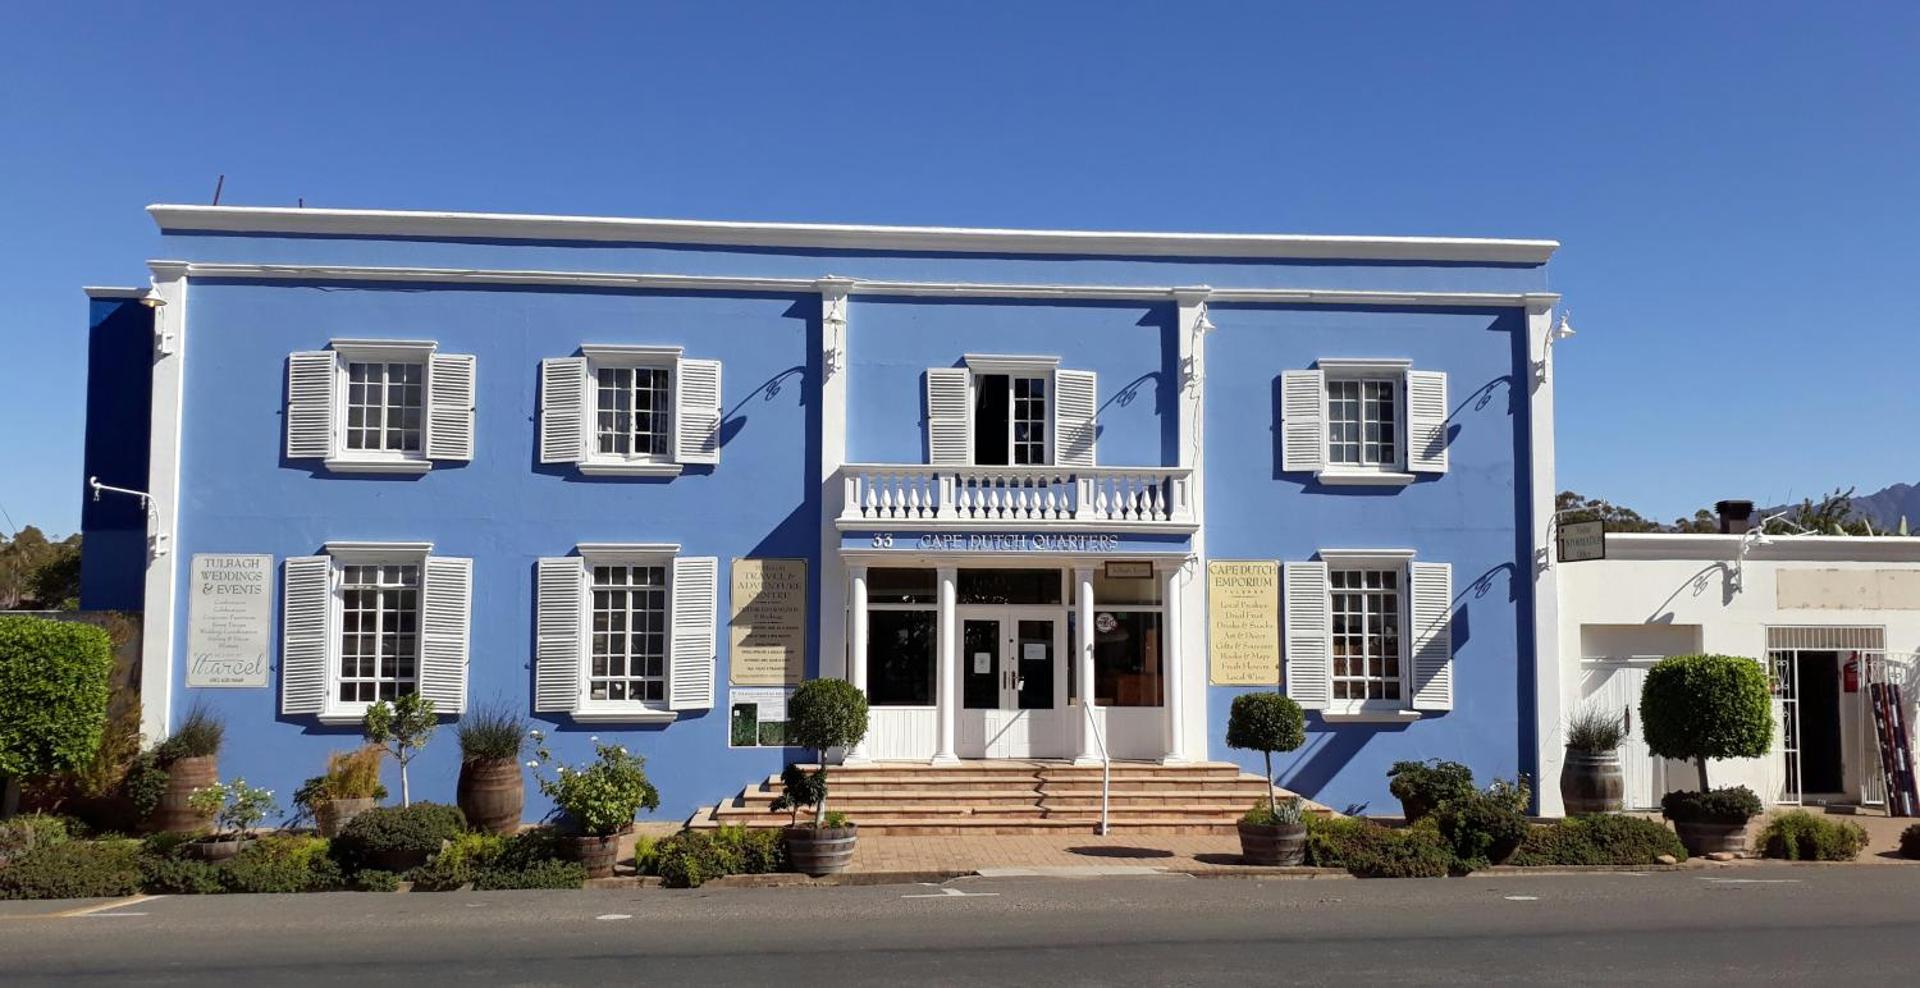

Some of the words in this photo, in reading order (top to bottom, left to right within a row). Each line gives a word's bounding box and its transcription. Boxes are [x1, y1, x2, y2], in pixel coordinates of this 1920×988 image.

[871, 533, 893, 548] 33
[919, 534, 963, 548] CAPE
[970, 534, 1025, 548] DUTCH
[1032, 535, 1118, 549] QUARTERS
[204, 558, 259, 569] TULBAGH
[200, 571, 263, 581] WEDDINGS
[1209, 566, 1239, 575] CAPE
[1241, 566, 1276, 575] DUTCH
[1215, 577, 1272, 587] EMPORIUM
[202, 583, 214, 595] &
[217, 584, 262, 595] EVENTS
[191, 653, 264, 675] Marcel
